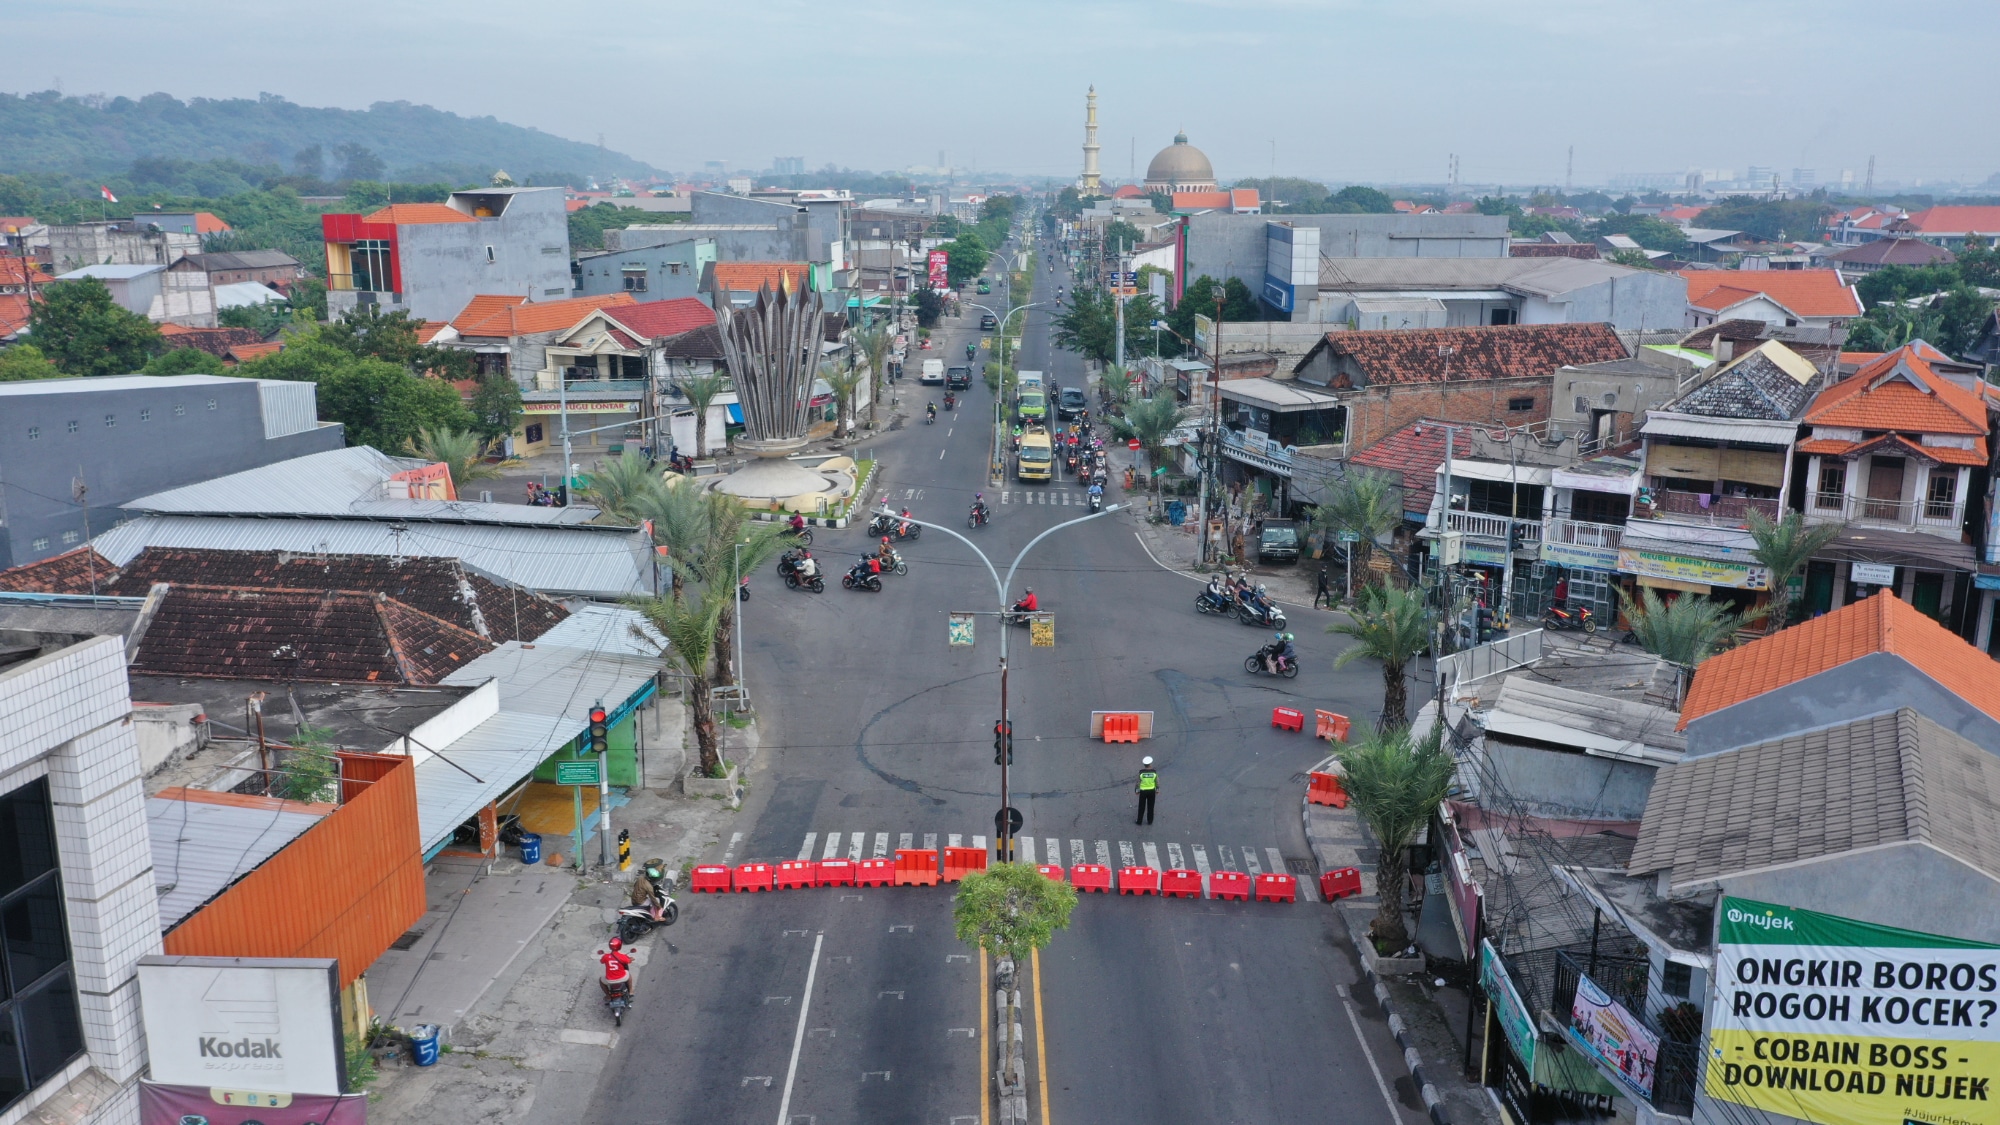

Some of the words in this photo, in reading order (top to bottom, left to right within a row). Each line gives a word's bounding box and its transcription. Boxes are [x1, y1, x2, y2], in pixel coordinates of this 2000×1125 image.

[591, 402, 625, 410] LONTAR
[1640, 552, 1672, 562] MEUBEL
[1675, 556, 1704, 566] ARIFIN
[1736, 957, 1863, 988] ONGKIR
[1873, 961, 1997, 992] BOROS
[1732, 990, 1851, 1021] ROGOH
[1861, 996, 1998, 1028] KOCEK?
[199, 1037, 283, 1059] Kodak
[1753, 1037, 1860, 1065] COBAIN
[1869, 1043, 1947, 1071] BOSS
[1724, 1063, 1886, 1095] DOWNLOAD
[1895, 1073, 1991, 1101] NUJEK
